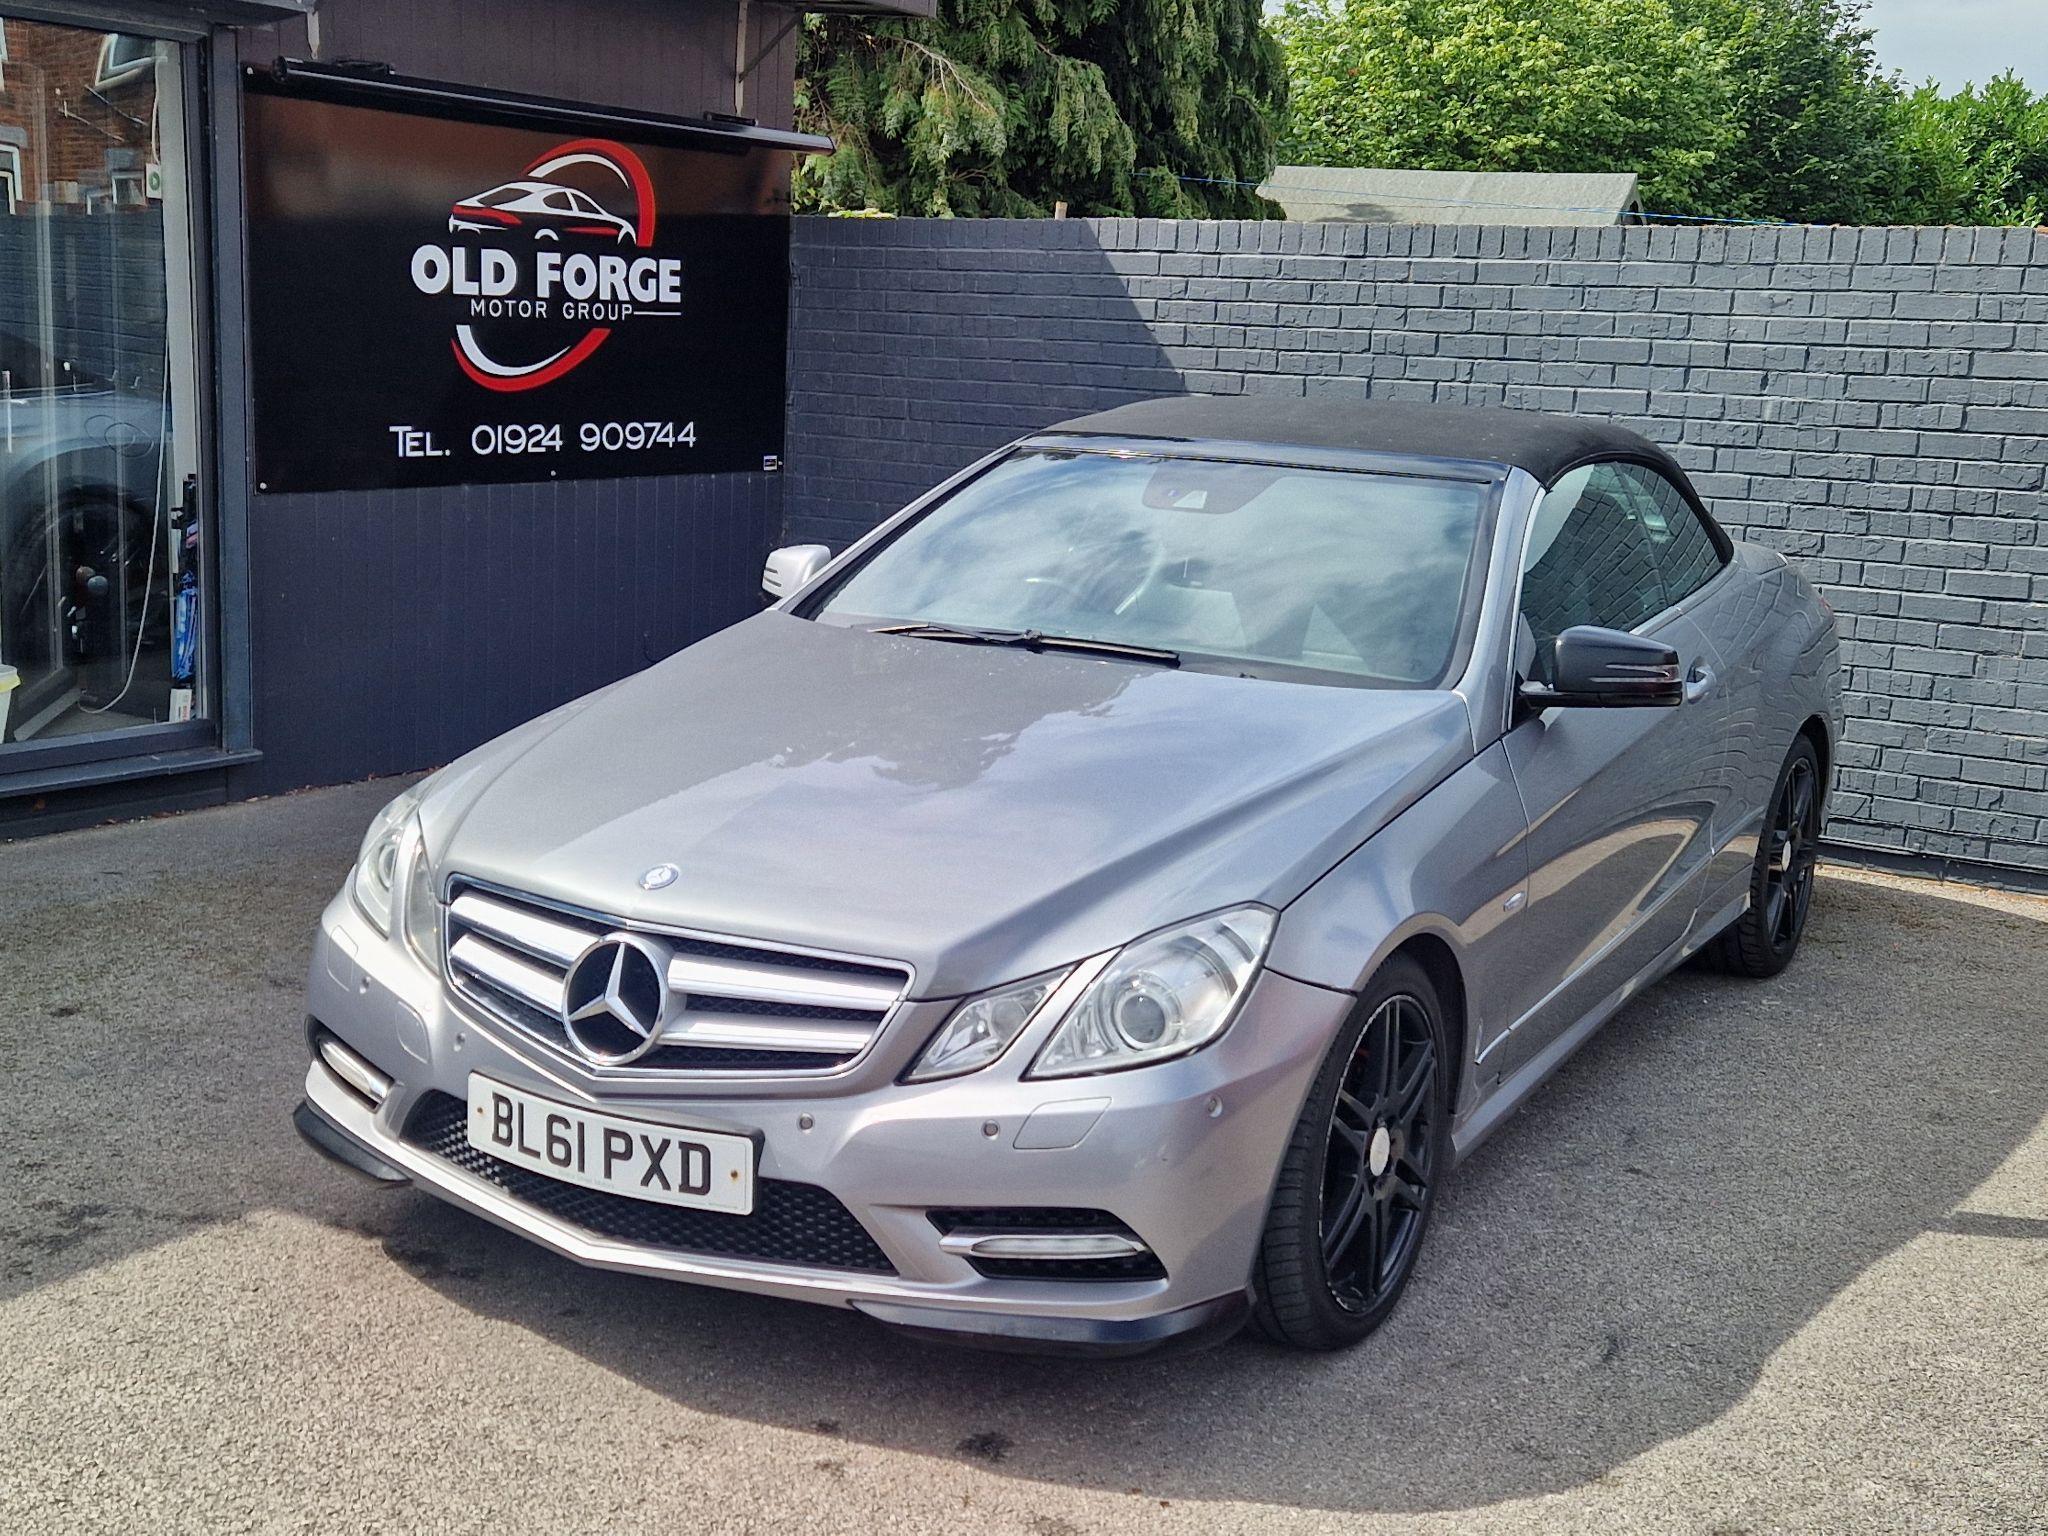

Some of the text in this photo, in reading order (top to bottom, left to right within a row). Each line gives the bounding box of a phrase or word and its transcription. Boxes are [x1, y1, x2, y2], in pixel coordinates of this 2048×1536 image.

[411, 244, 682, 303] OLD FORGE
[470, 299, 633, 321] MOTOR GROUP
[389, 421, 697, 457] TEL. 01924 909744
[492, 1092, 711, 1196] BL61 PXD
